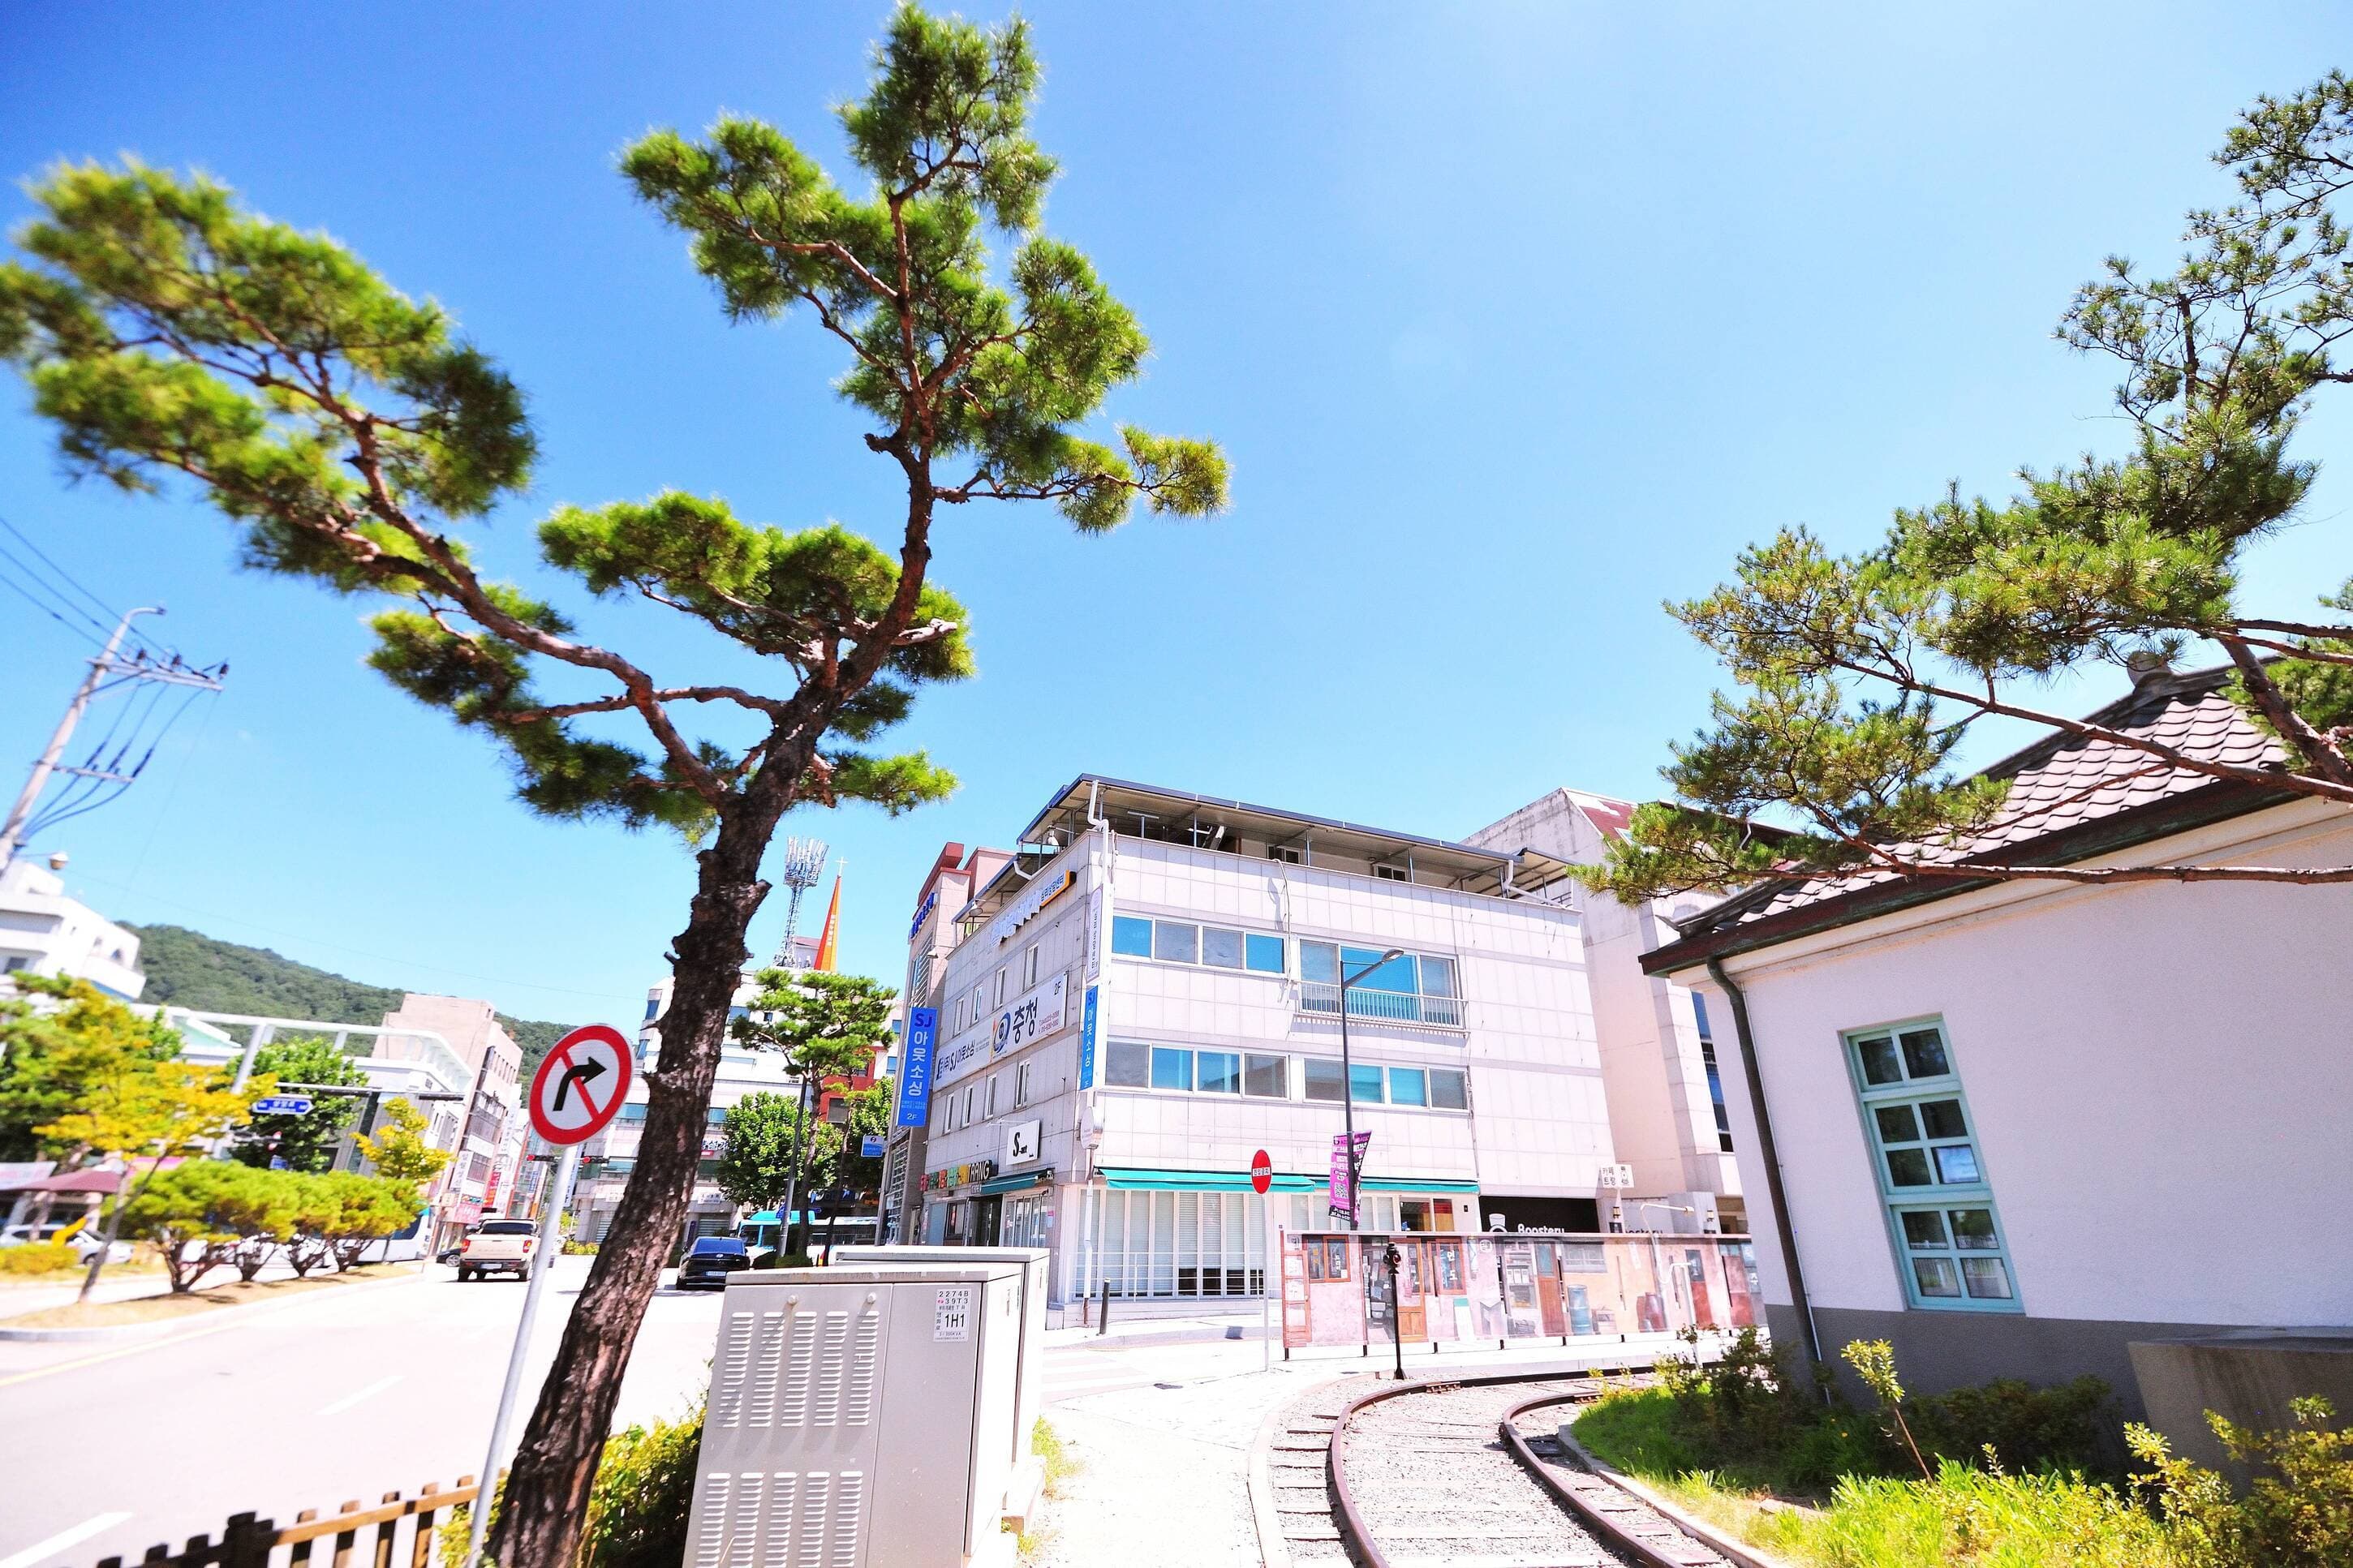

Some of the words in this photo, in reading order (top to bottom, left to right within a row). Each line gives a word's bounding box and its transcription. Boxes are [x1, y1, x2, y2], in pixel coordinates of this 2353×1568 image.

[1054, 980, 1061, 996] 2F
[1087, 991, 1095, 1006] SJ
[914, 1012, 932, 1028] SJ
[1013, 996, 1039, 1044] 충청
[1085, 1009, 1094, 1068] 아웃소싱
[908, 1031, 928, 1097] 아웃소싱
[969, 1160, 990, 1183] TRANG
[1254, 1168, 1269, 1176] 진입금지
[1602, 1166, 1615, 1176] 카페
[1603, 1176, 1616, 1186] 트랑
[944, 1313, 965, 1328] 1H1
